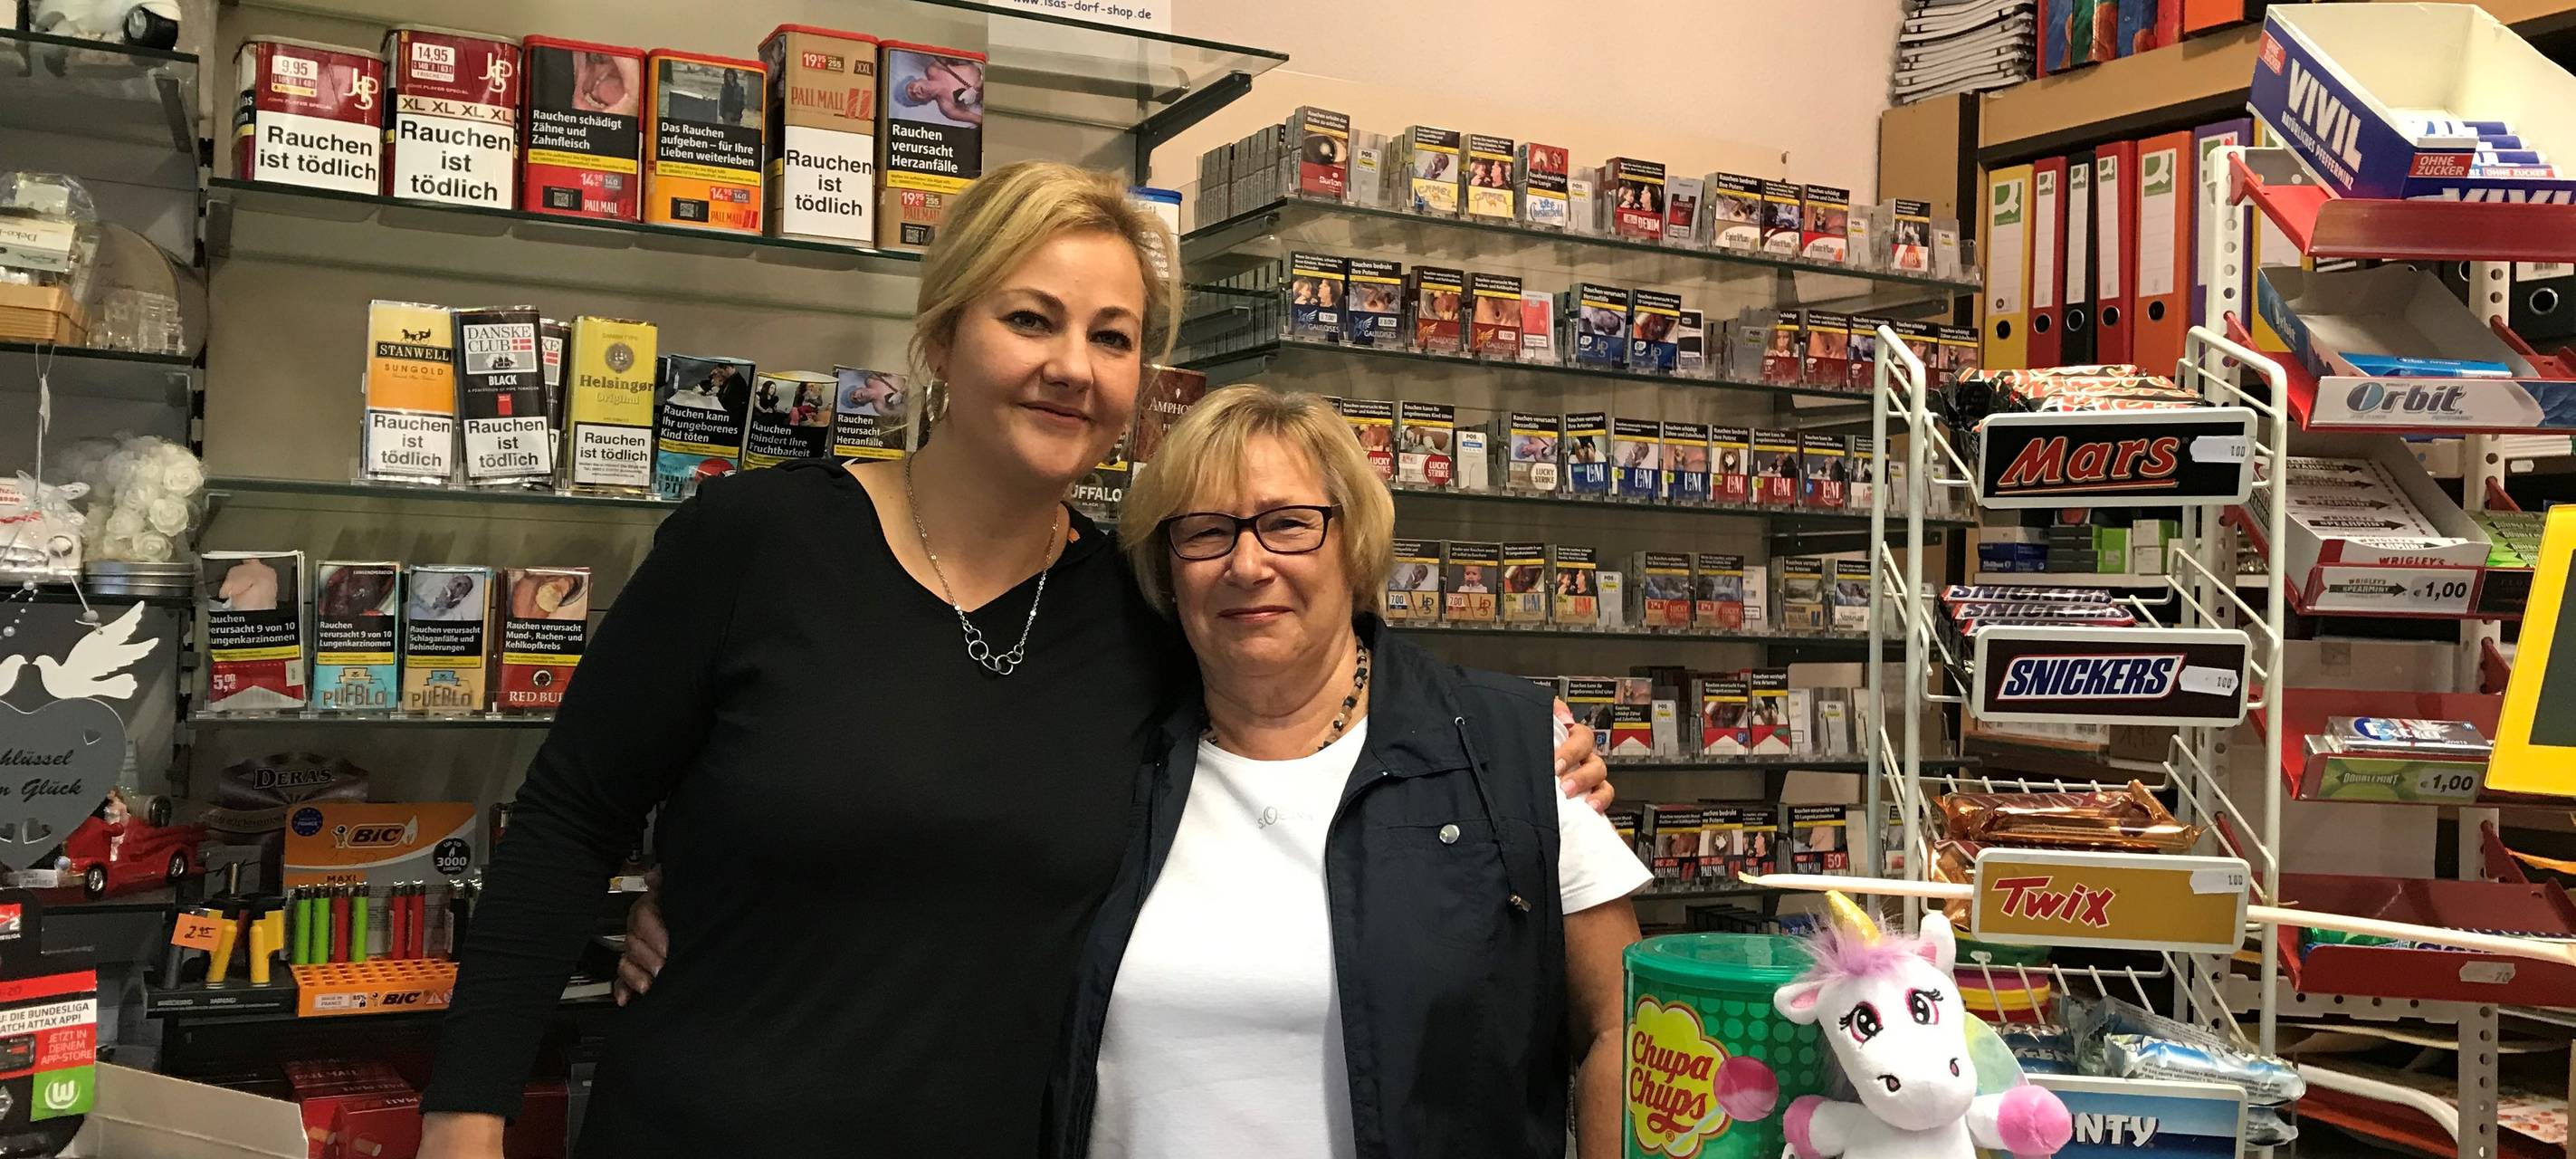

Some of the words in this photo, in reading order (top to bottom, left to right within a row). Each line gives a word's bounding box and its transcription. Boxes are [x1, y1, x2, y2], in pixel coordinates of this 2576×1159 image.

[418, 46, 449, 62] 14,95
[791, 87, 816, 106] PALL
[817, 91, 844, 110] MALL
[402, 98, 425, 110] XL
[432, 101, 455, 114] XL
[462, 105, 484, 118] XL
[491, 109, 512, 122] XL
[2288, 58, 2362, 173] VIVIL
[533, 110, 577, 123] Rauchen
[579, 115, 622, 130] schädigt
[401, 120, 510, 152] Rauchen
[532, 122, 565, 135] Zähne
[567, 128, 587, 137] und
[662, 121, 680, 133] Das
[682, 124, 724, 139] Rauchen
[892, 124, 942, 141] Rauchen
[268, 125, 372, 157] Rauchen
[532, 135, 590, 149] Zahnfleisch
[661, 135, 708, 149] aufgeben
[719, 140, 732, 152] für
[735, 142, 754, 155] Ihre
[661, 147, 693, 159] Lieben
[696, 151, 754, 167] weiterleben
[892, 142, 954, 158] verursacht
[260, 149, 289, 169] ist
[297, 154, 376, 181] tödlich
[442, 150, 472, 172] ist
[786, 149, 873, 176] Rauchen
[892, 155, 959, 174] Herzanfälle
[2315, 144, 2354, 191] PFEFFERMINZ
[2420, 156, 2455, 166] OHNE
[2416, 166, 2465, 176] ZUCKER
[410, 174, 498, 201] tödlich
[817, 175, 843, 193] ist
[1418, 185, 1452, 196] CAMEL
[584, 198, 598, 211] PALL
[601, 201, 617, 214] MALL
[795, 193, 863, 216] tödlich
[1474, 192, 1506, 204] CAMEL
[1638, 216, 1660, 232] DENIM
[468, 326, 531, 340] DANSKE
[379, 345, 450, 361] STANWELL
[468, 340, 510, 352] CLUB
[385, 363, 444, 376] SUNGOLD
[489, 375, 517, 386] BLACK
[580, 374, 653, 394] Helsingør
[1149, 397, 1193, 415] AMPHO
[2347, 382, 2466, 414] Orbit
[663, 405, 704, 419] Rauchen
[706, 410, 730, 422] kann
[837, 414, 873, 426] Rauchen
[374, 414, 450, 433] Rauchen
[469, 419, 544, 434] Rauchen
[663, 416, 675, 427] Ihr
[677, 420, 739, 435] ungeborenes
[752, 421, 792, 436] Rauchen
[837, 426, 881, 436] verursacht
[402, 434, 424, 448] ist
[498, 436, 519, 449] ist
[585, 432, 644, 446] Rauchen
[661, 427, 682, 440] Kind
[684, 432, 710, 443] töten
[750, 433, 787, 445] mindert
[789, 437, 807, 447] Ihre
[836, 436, 883, 448] Herzanfälle
[580, 447, 597, 458] ist
[601, 448, 647, 462] tödlich
[749, 442, 810, 457] Fruchtbarkeit
[381, 450, 442, 467] tödlich
[480, 453, 538, 467] tödlich
[1428, 461, 1449, 469] LUCKY
[1997, 436, 2180, 487] Mars
[1428, 470, 1449, 478] STRIKE
[1535, 468, 1554, 476] LUCKY
[1535, 476, 1555, 484] STRIKE
[1072, 485, 1122, 502] UFFALO
[2426, 581, 2467, 601] 1,00
[211, 615, 245, 624] auchen
[320, 621, 353, 629] Rauchen
[506, 621, 540, 630] Rauchen
[541, 624, 581, 632] verursacht
[210, 625, 254, 634] erursacht
[257, 625, 262, 633] 9
[285, 622, 295, 630] 10
[410, 626, 442, 634] Rauchen
[506, 631, 534, 640] Mund-,
[535, 633, 567, 641] Rachen-
[568, 633, 583, 641] und
[211, 634, 295, 647] ungenkarzinomen
[320, 639, 391, 649] Lungenkarzinomen
[410, 635, 459, 644] Schlaganfälle
[505, 641, 560, 650] Kehlkopfkrebs
[409, 644, 465, 652] Behinderungen
[2003, 657, 2176, 695] SNICKERS
[412, 685, 472, 707] PUEBLO
[509, 691, 536, 702] RED
[0, 748, 74, 767] hlüssel
[253, 768, 333, 790] DERAS
[2342, 772, 2399, 786] DOUBLEMINT
[2433, 775, 2473, 791] 1,00
[22, 778, 82, 802] Glück
[436, 857, 467, 867] 3000
[327, 875, 357, 884] MAXI
[1992, 876, 2115, 928] Twix
[9, 917, 20, 930] 2
[10, 1011, 25, 1021] DIE
[28, 1002, 90, 1019] BUNDESLIGA
[0, 1021, 25, 1034] ATCH
[27, 1018, 57, 1031] ATTAX
[59, 1014, 81, 1026] APP!
[49, 1031, 76, 1043] JETZT
[77, 1030, 87, 1039] IN
[49, 1040, 85, 1052] DEINEM
[41, 1049, 92, 1065] APP-STORE
[1632, 1031, 1714, 1084] Chupa
[1630, 1067, 1708, 1134] Chups
[2075, 1113, 2160, 1147] NTY
